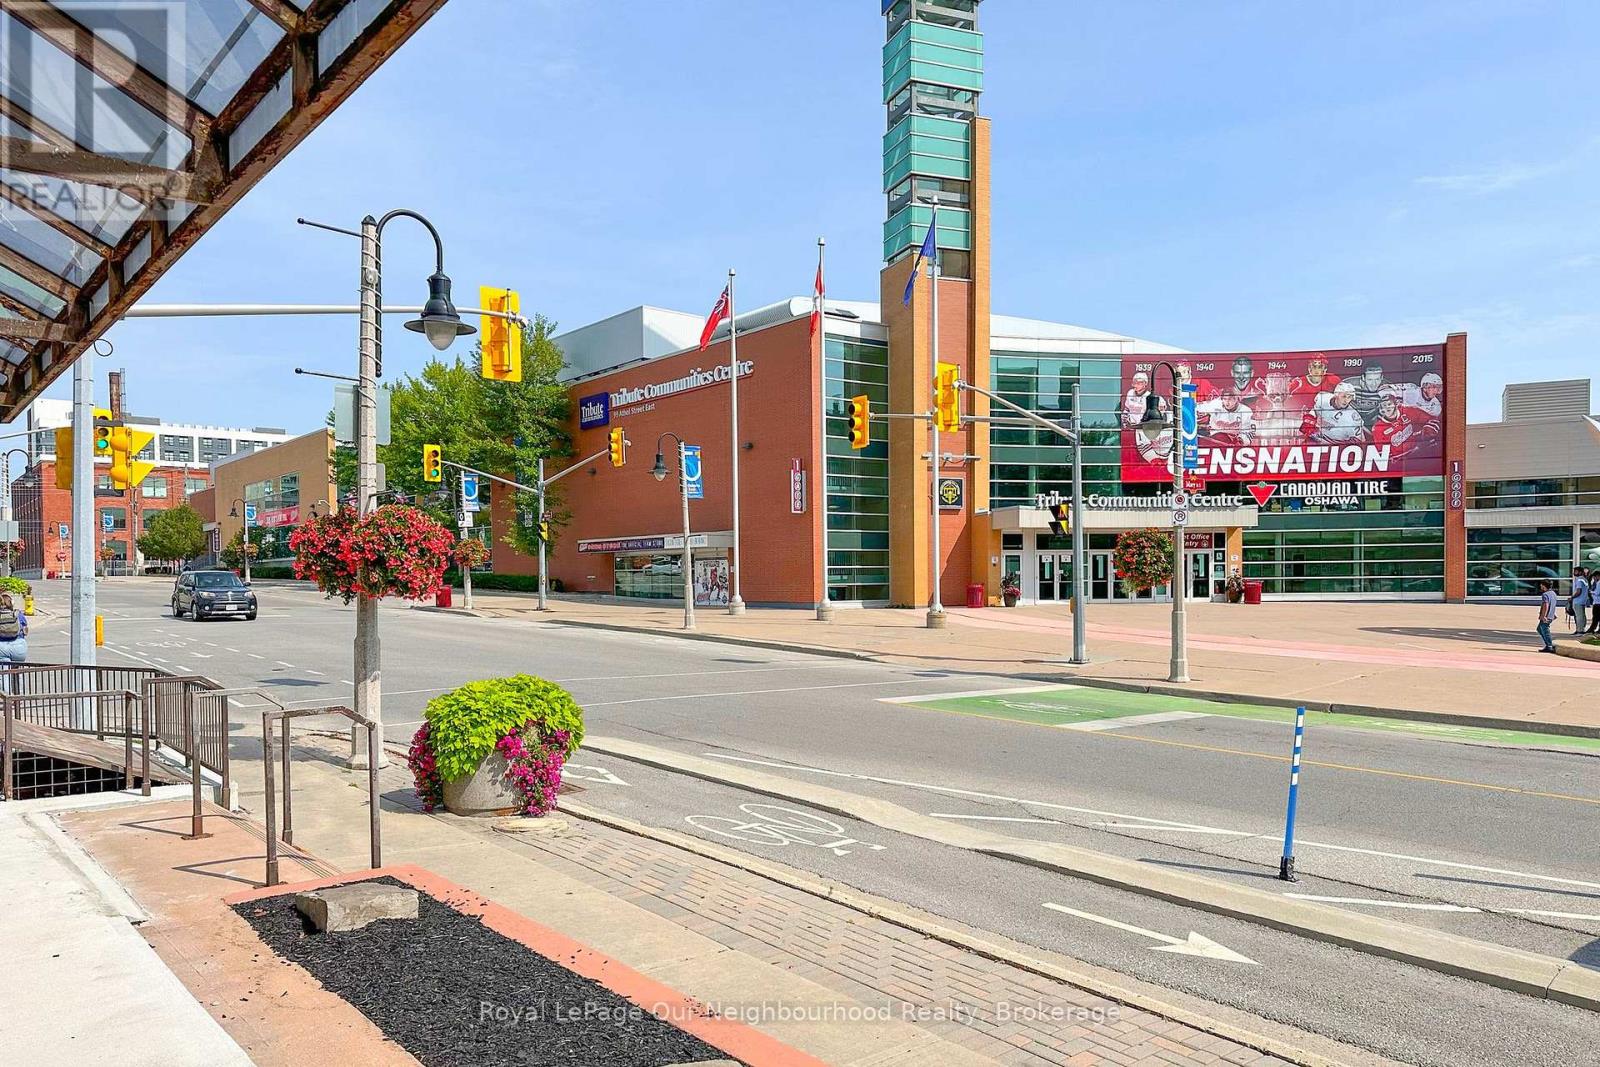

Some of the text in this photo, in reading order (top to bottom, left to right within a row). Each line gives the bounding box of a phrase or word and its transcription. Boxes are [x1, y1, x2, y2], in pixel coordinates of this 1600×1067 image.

[1343, 358, 1362, 367] 1990
[1412, 354, 1433, 363] 2015
[1135, 363, 1152, 371] 1939
[1196, 363, 1214, 371] 1940
[1268, 361, 1287, 369] 1944
[610, 388, 644, 407] Tribute
[644, 368, 713, 399] Communities
[581, 402, 604, 418] Tribute
[1453, 462, 1459, 472] 1
[1280, 481, 1388, 496] CANADIAN TIRE
[1190, 493, 1244, 508] Centre
[1305, 496, 1359, 505] OSHAWA
